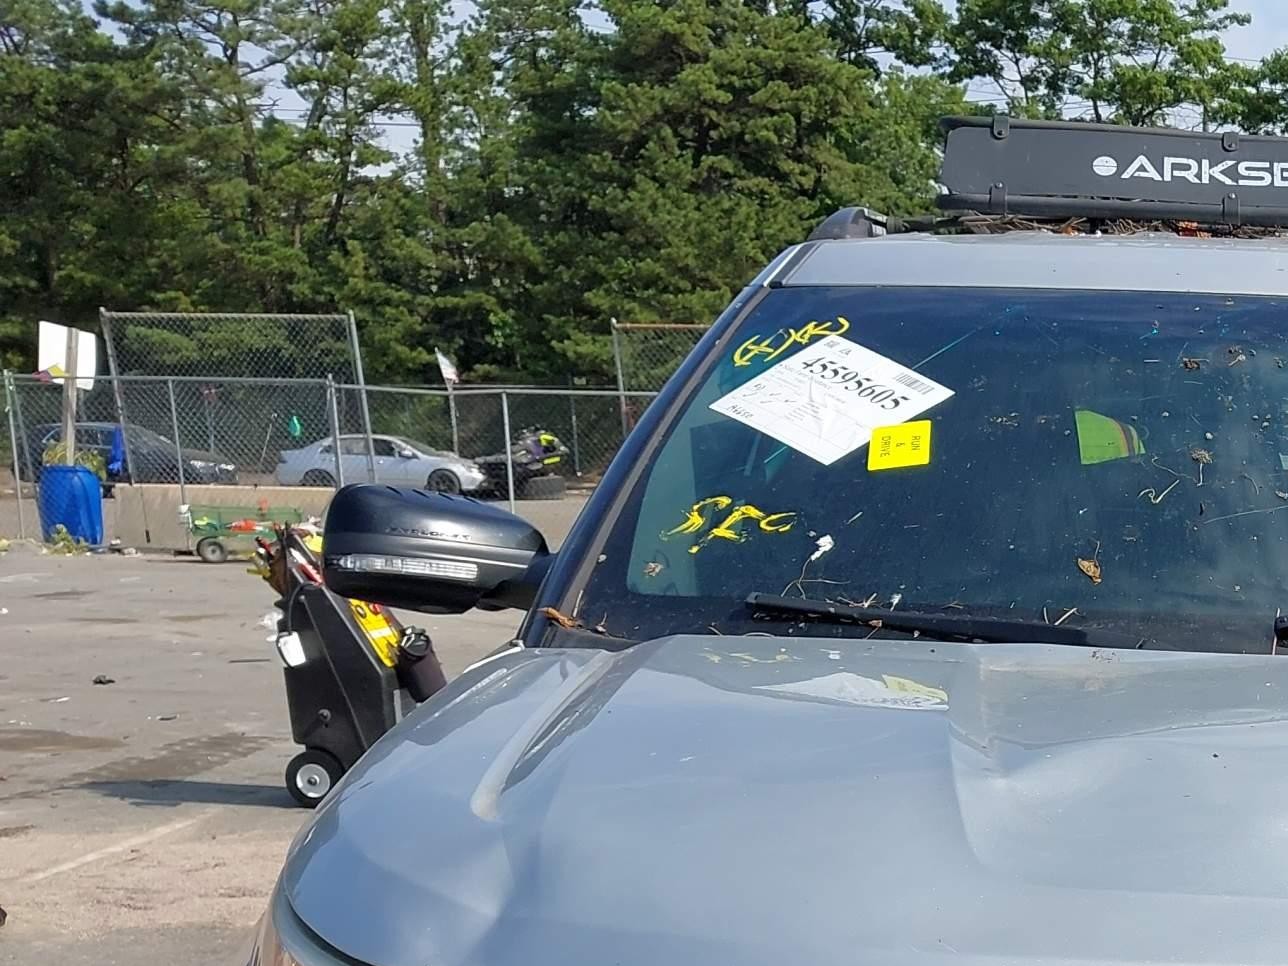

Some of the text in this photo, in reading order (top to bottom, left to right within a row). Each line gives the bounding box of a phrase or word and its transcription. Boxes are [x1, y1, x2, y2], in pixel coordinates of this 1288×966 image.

[801, 356, 910, 410] 45595605
[880, 435, 891, 458] DRIVE
[911, 435, 921, 451] RUN
